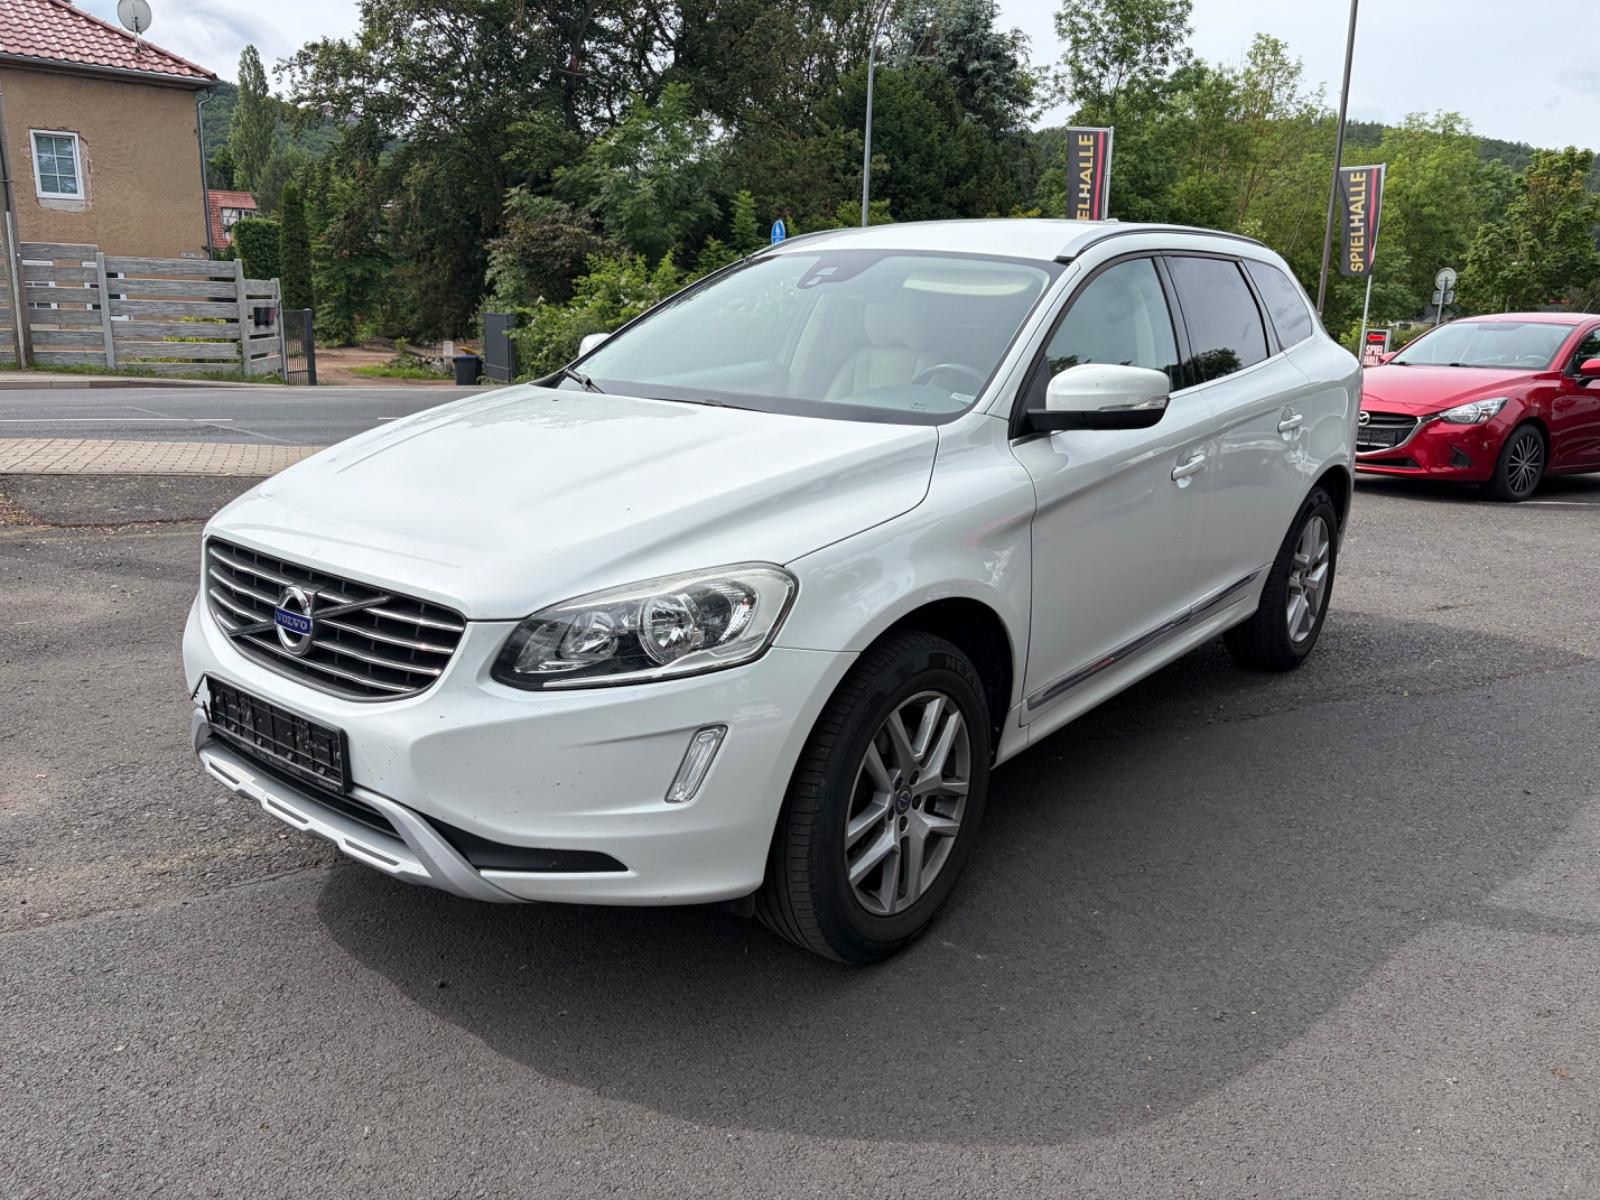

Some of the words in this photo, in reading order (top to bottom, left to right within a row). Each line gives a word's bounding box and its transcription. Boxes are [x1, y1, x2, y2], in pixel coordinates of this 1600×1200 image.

[1077, 134, 1095, 221] ELHALLE
[1349, 172, 1367, 272] SPIELHALLE
[1366, 344, 1383, 355] SPIEL
[1364, 355, 1380, 366] HALL
[277, 611, 308, 631] VOLVO
